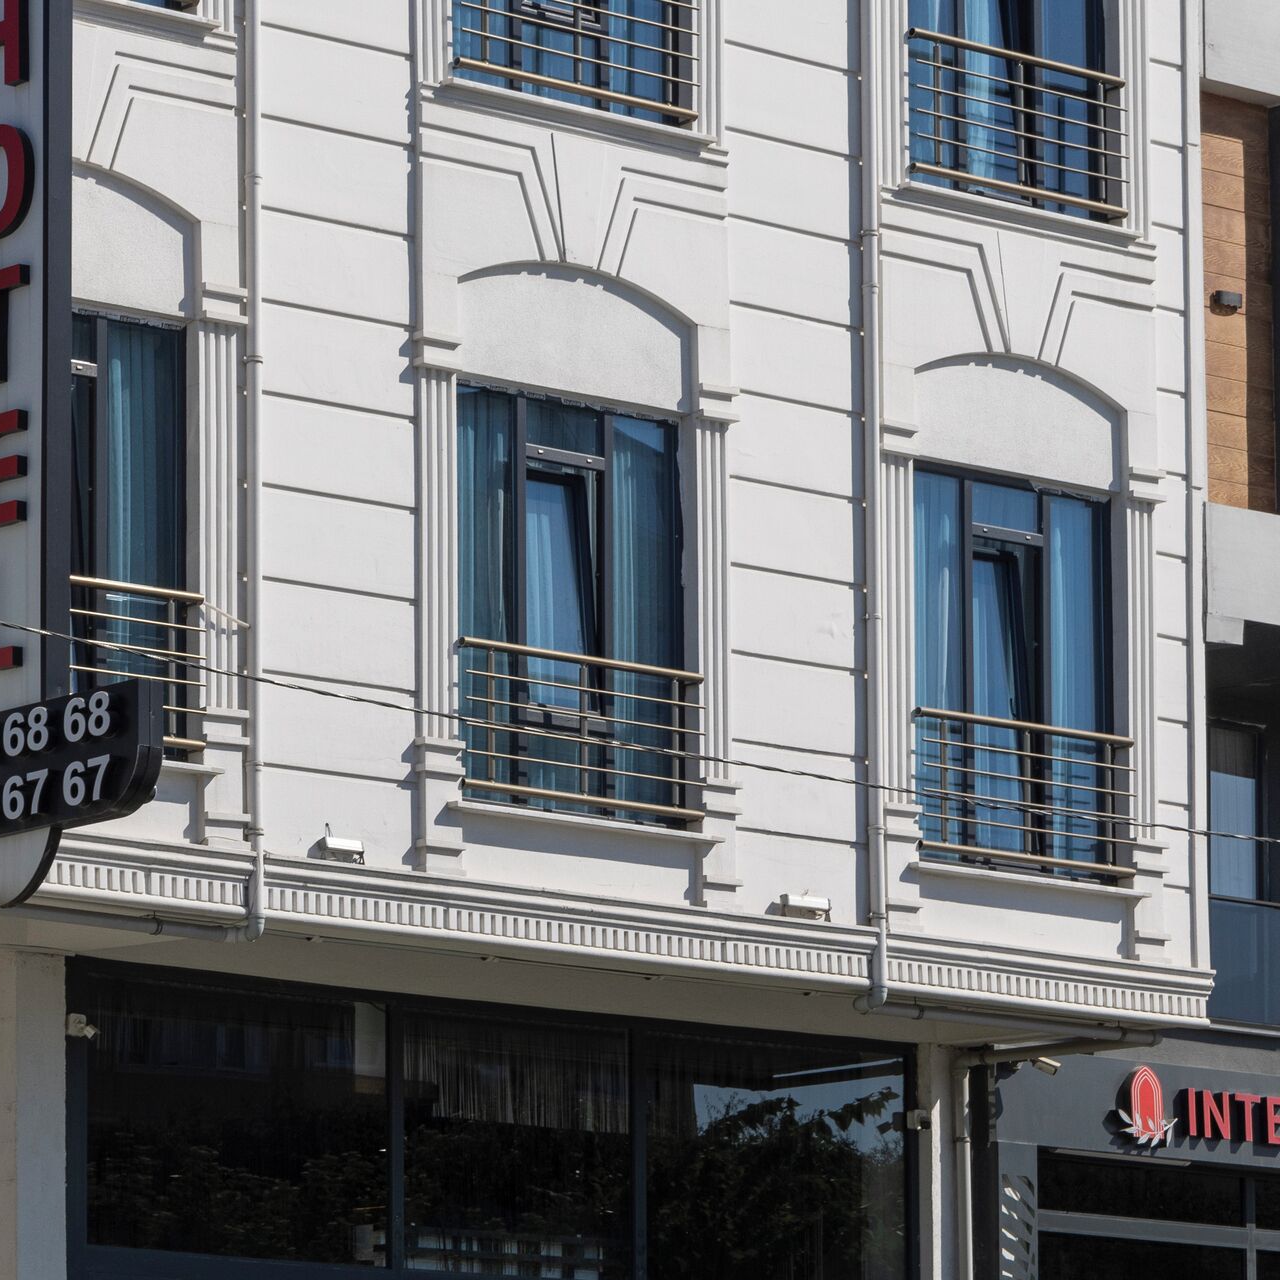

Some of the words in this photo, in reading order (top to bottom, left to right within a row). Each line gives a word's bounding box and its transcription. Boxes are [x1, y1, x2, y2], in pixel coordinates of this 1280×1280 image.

[3, 706, 48, 757] 68
[63, 691, 110, 742] 68
[2, 769, 49, 820] 67
[63, 755, 110, 806] 67
